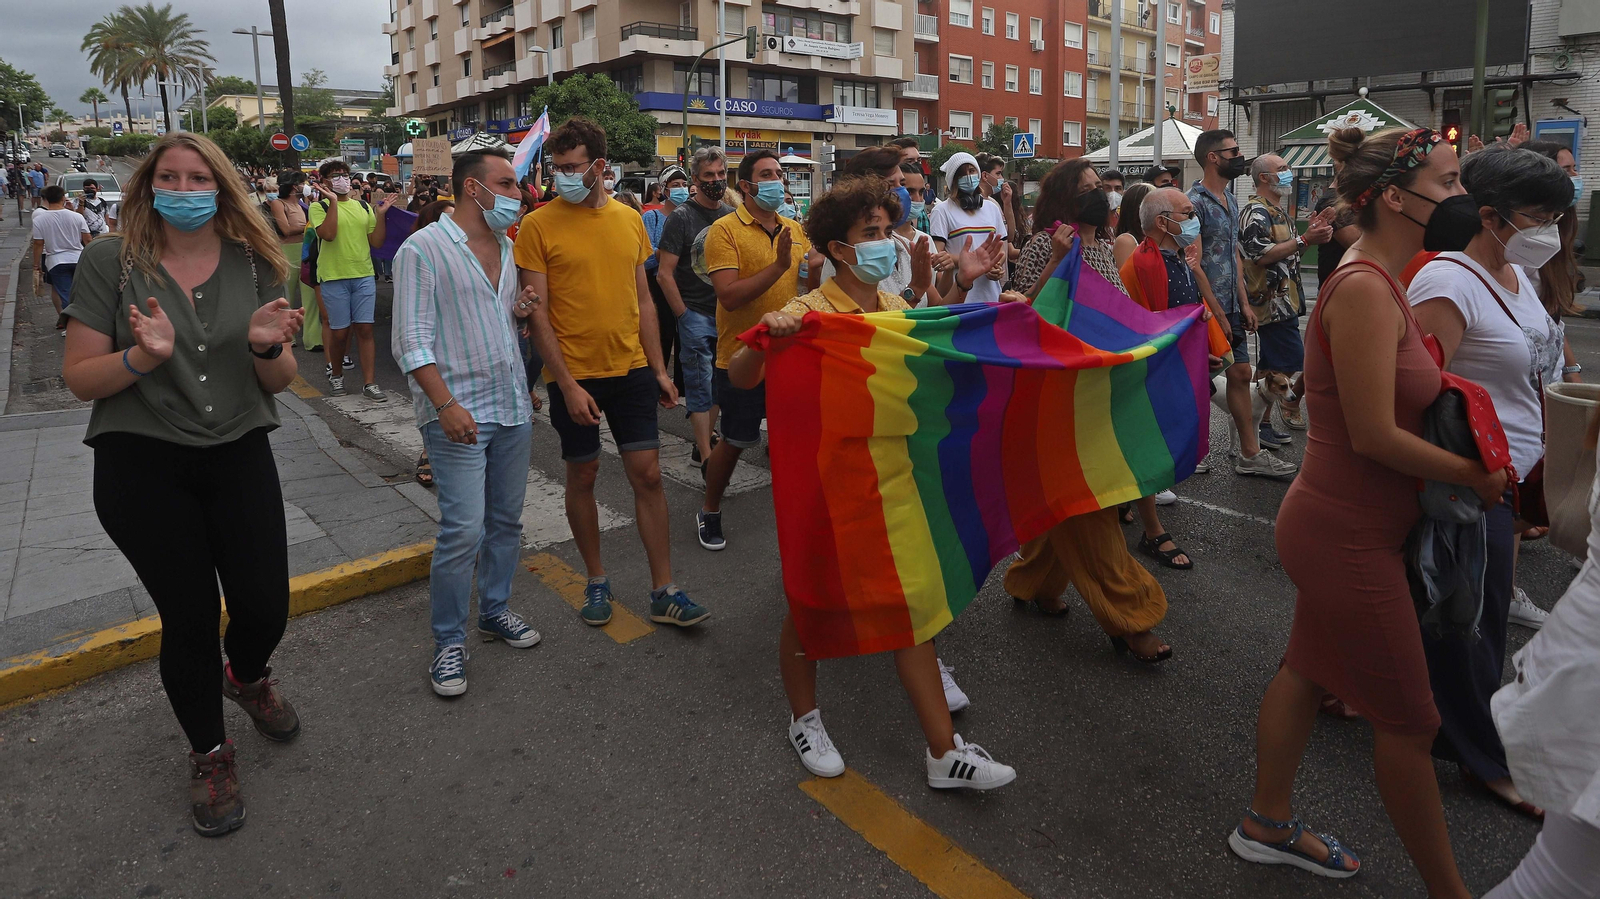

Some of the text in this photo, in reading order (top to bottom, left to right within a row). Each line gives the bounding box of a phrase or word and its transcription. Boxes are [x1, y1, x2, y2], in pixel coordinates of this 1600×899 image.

[714, 99, 794, 116] OCASO SEGUROS
[735, 129, 762, 139] Kodak
